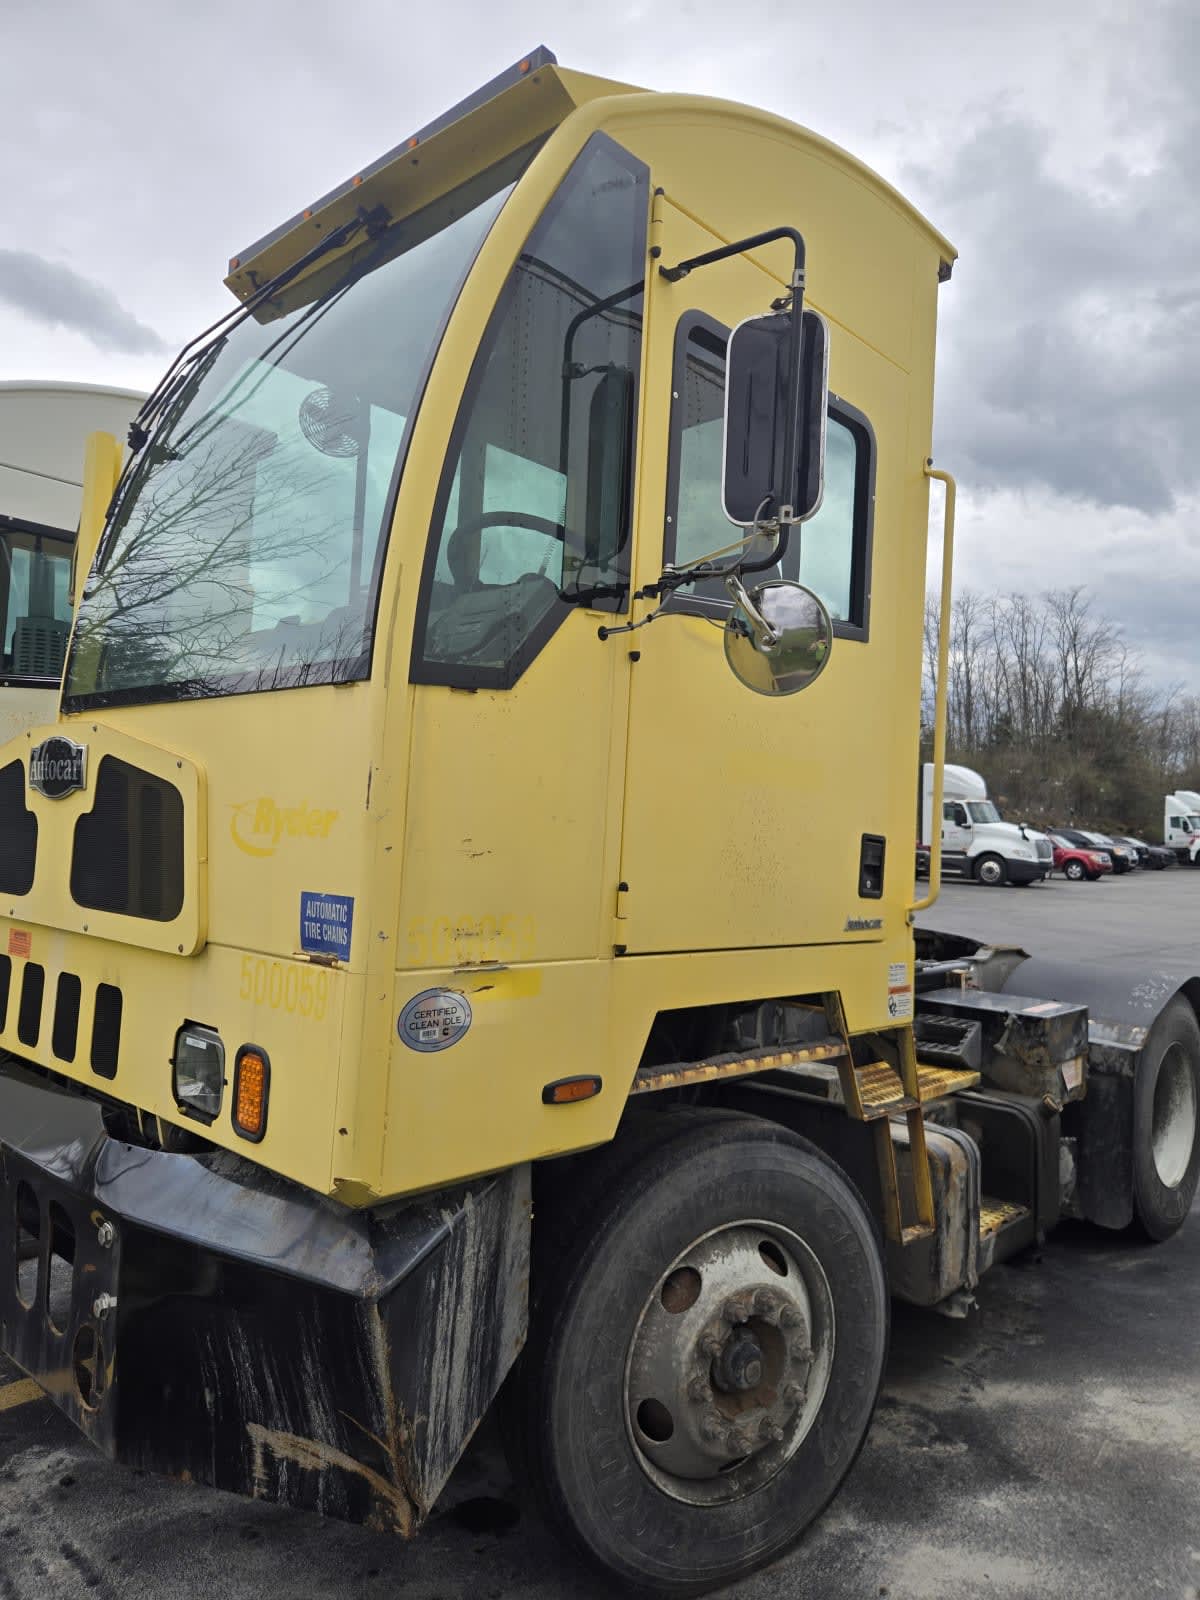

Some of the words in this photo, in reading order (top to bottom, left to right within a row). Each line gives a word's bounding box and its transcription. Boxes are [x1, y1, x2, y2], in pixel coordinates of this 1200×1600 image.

[30, 759, 80, 781] Autocar
[250, 796, 339, 844] Ryder
[305, 900, 348, 923] AUTOMATIC
[303, 921, 321, 940] TIRE
[322, 924, 348, 945] CHAINS
[239, 954, 329, 1021] 500059
[409, 1019, 439, 1031] CLEAN
[443, 1016, 462, 1026] IDLE
[414, 1006, 457, 1019] CERTIFIED
